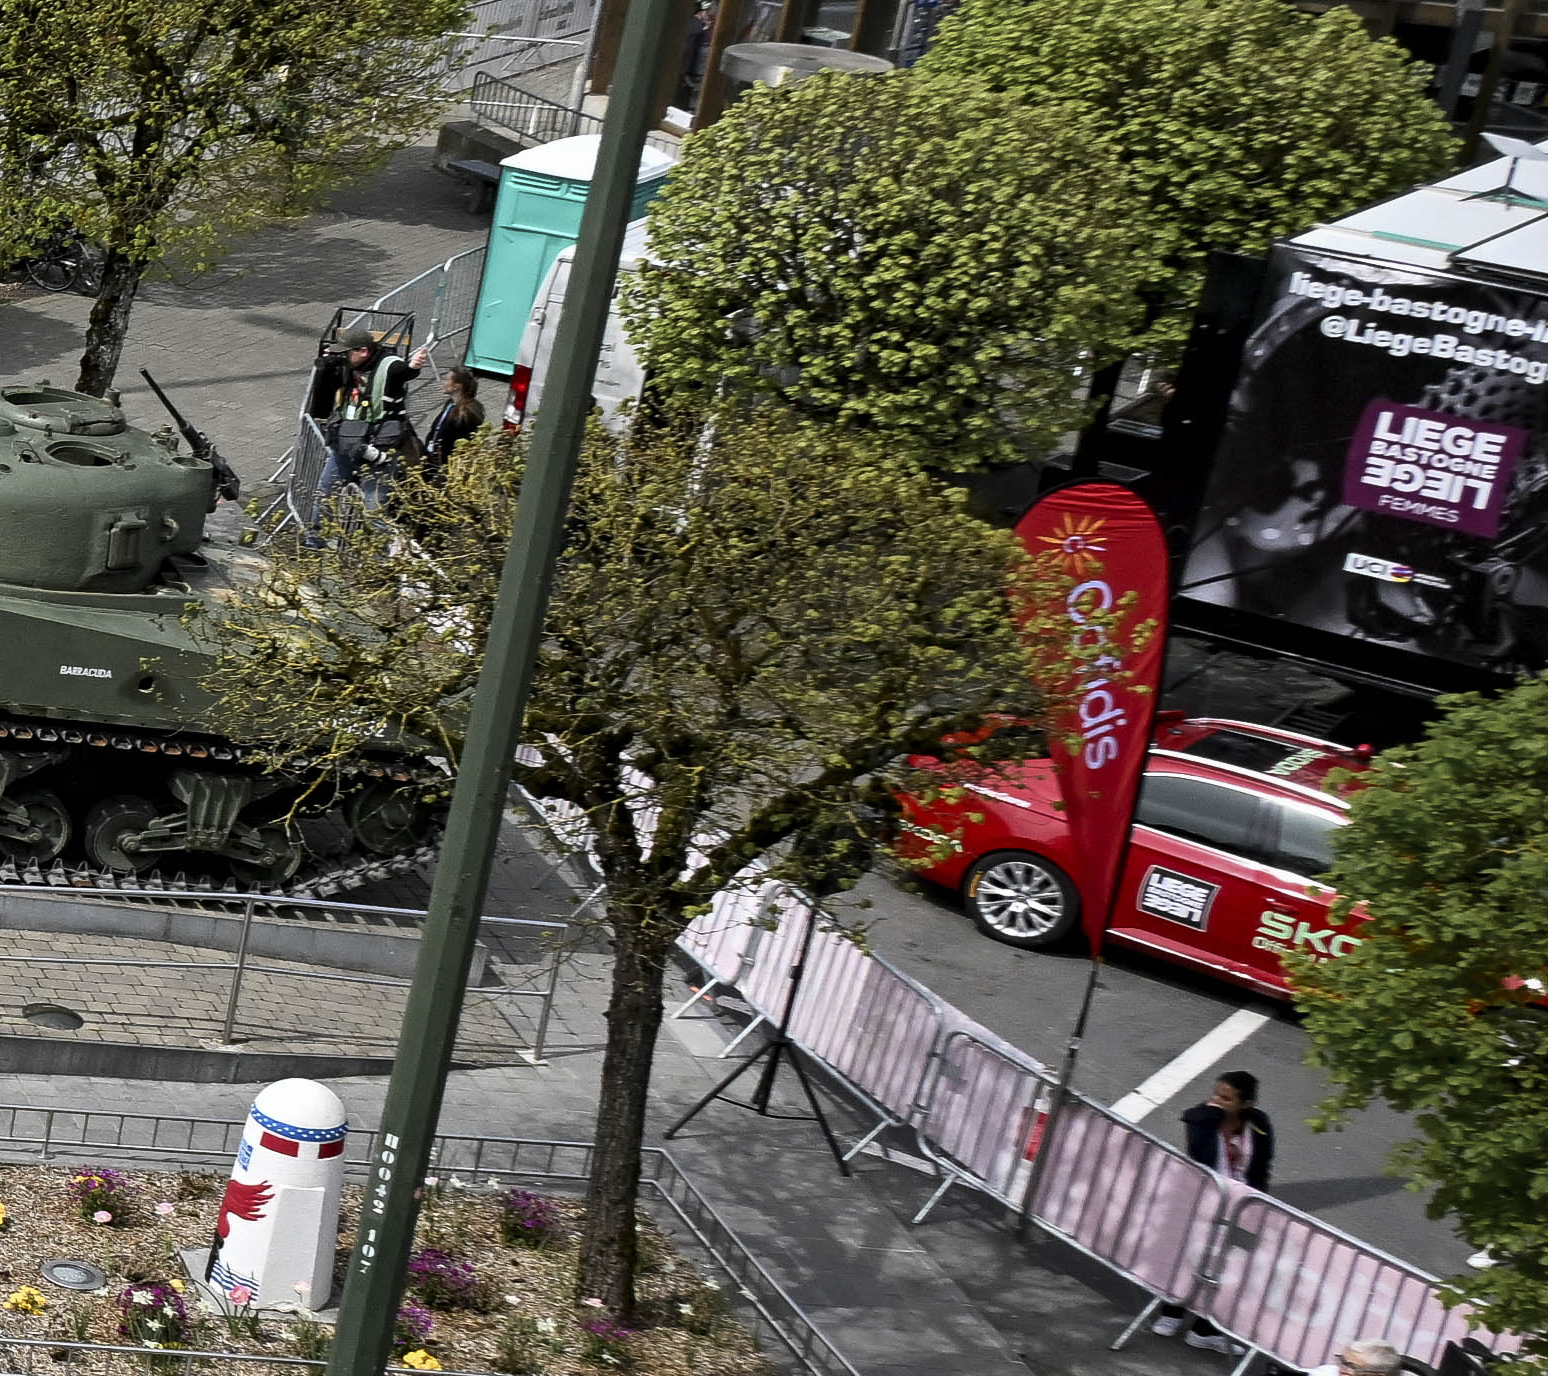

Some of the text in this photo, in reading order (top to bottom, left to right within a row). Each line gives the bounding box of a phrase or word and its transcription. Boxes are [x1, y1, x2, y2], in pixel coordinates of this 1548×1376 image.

[1372, 412, 1507, 463] LIEGE
[1369, 441, 1499, 480] BASTOGNE
[1360, 456, 1493, 510] LIEGE
[1379, 495, 1460, 523] FEMMES
[59, 665, 113, 679] BARRACUDA
[1148, 873, 1210, 898] LIEGE
